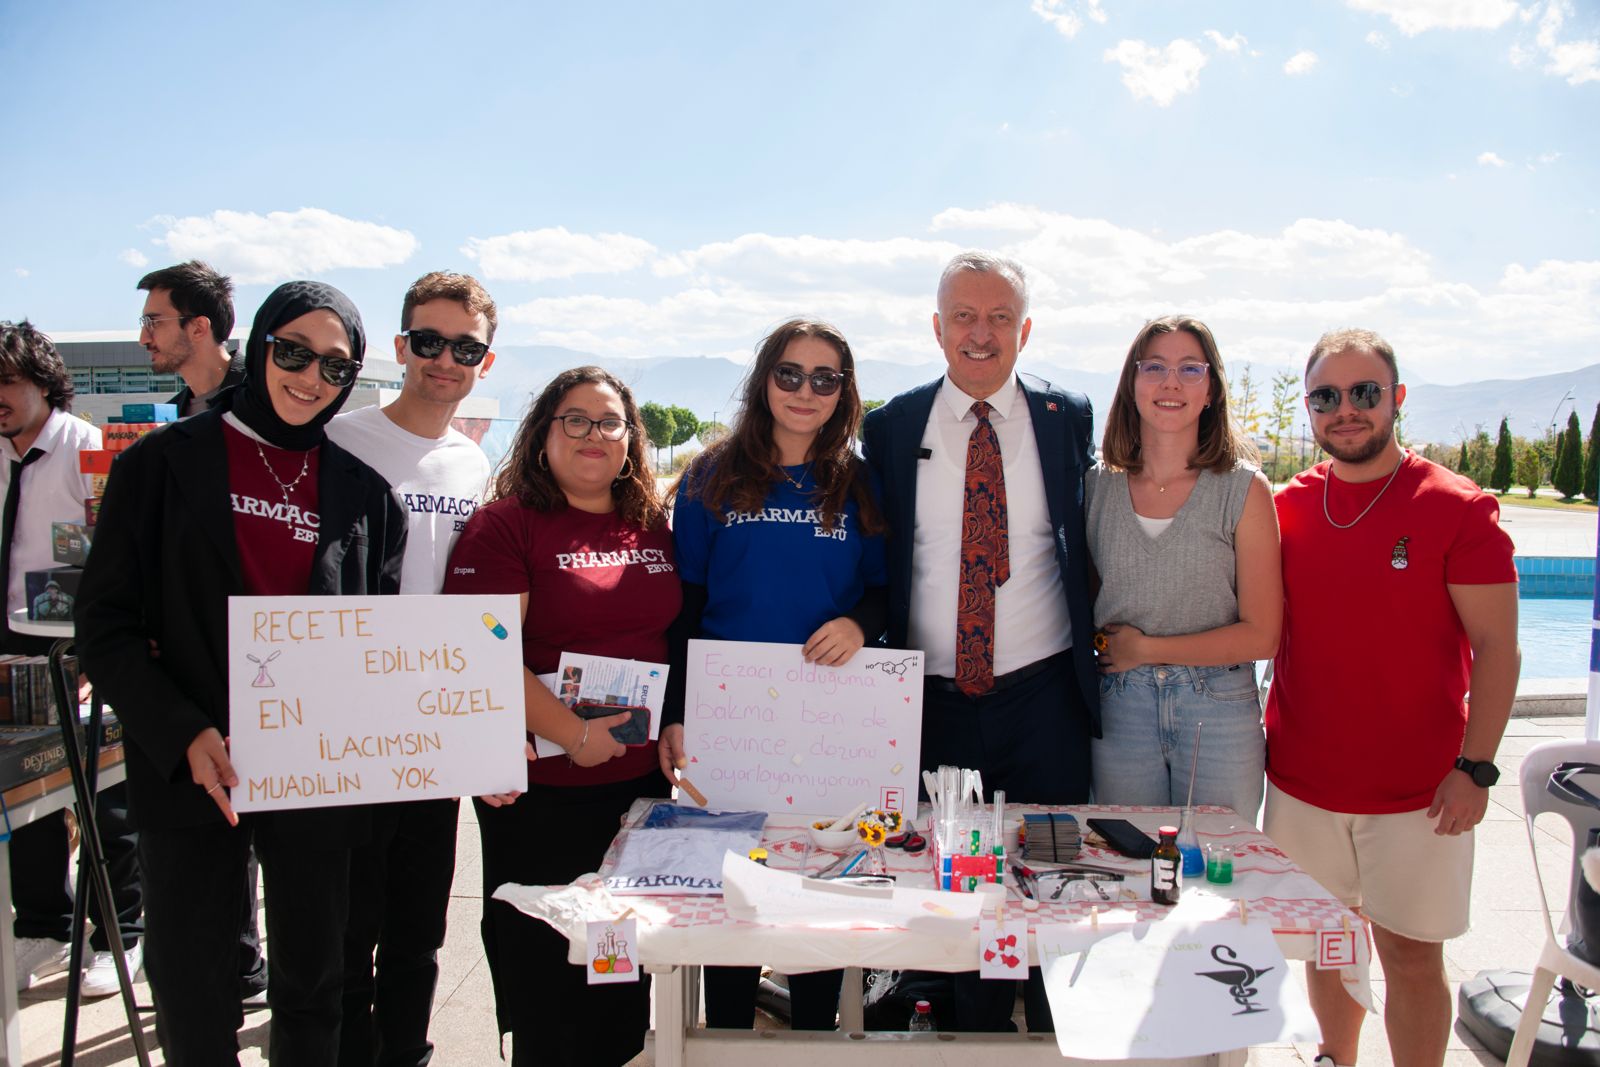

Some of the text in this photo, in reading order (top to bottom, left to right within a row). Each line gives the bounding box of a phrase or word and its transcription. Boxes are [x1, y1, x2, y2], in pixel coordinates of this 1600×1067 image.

[230, 493, 320, 528] ARMAC
[556, 548, 667, 569] PHARMACY
[253, 608, 373, 643] REÇETE
[364, 643, 467, 674] EDİLMİŞ
[259, 687, 504, 730] EN GÜZEL
[695, 690, 889, 729] bakma ben de
[319, 731, 441, 761] İLACIMSIN
[249, 766, 439, 802] MUADİLİN YOK
[885, 791, 899, 810] E
[1153, 858, 1175, 890] E
[1326, 938, 1342, 960] E
